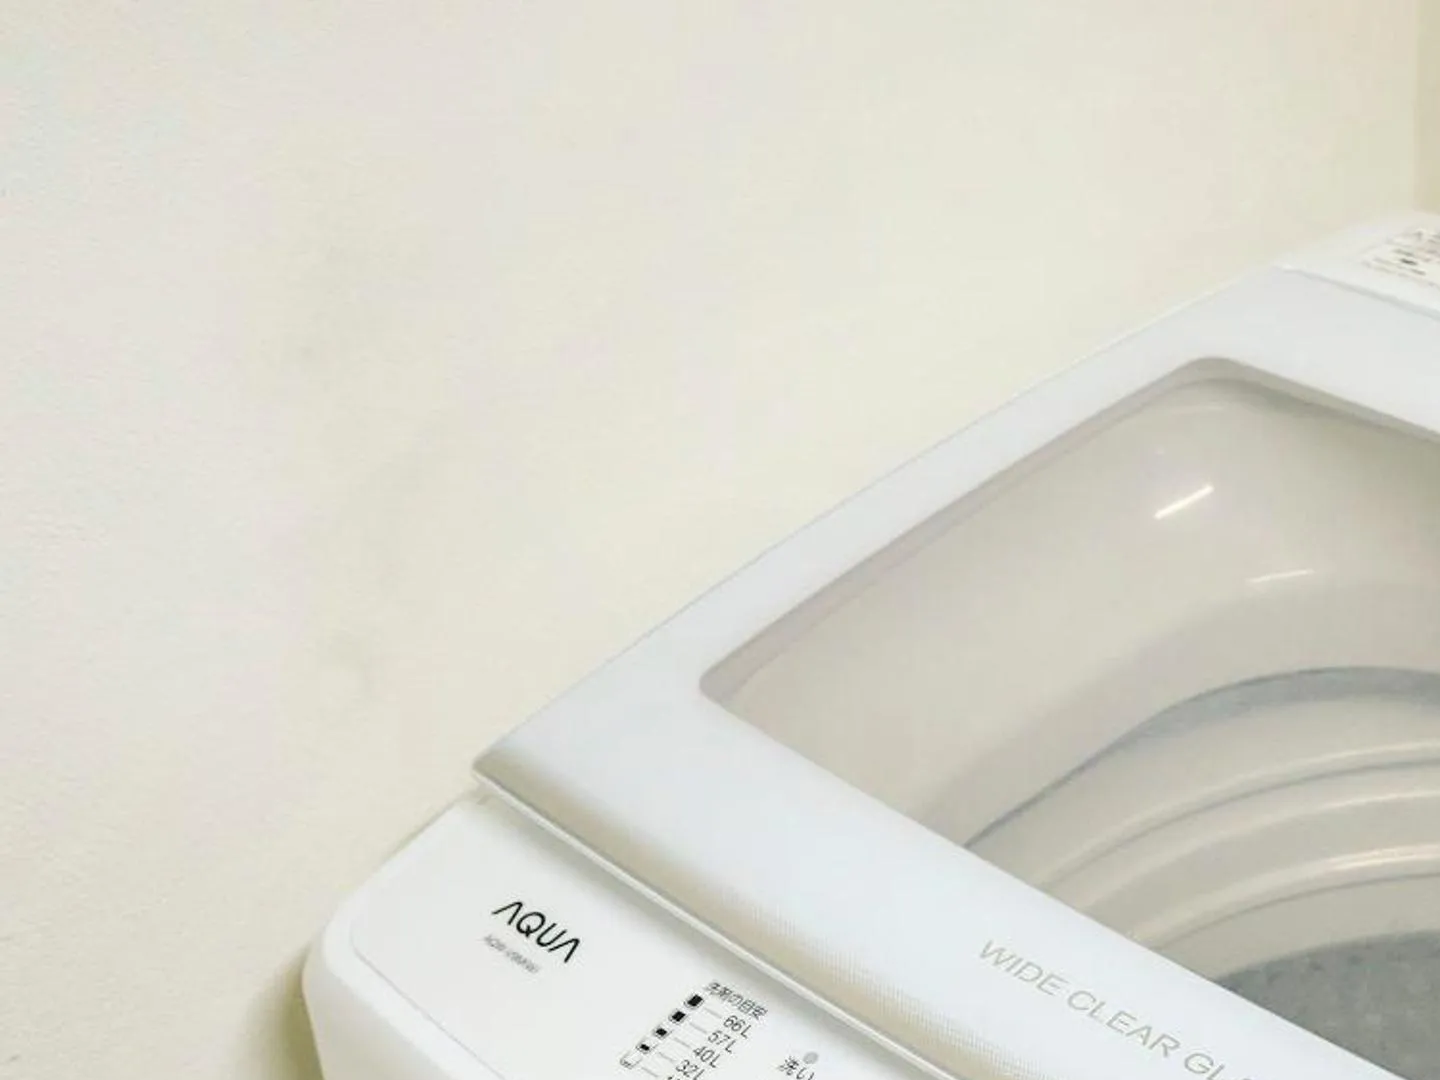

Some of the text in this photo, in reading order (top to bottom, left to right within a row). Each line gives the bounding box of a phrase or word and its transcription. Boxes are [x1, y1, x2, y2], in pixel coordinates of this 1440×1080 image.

[491, 900, 581, 964] AQUA
[978, 940, 1068, 996] WIDE
[1067, 990, 1181, 1059] CLEAR
[723, 1015, 753, 1039] 66L
[707, 1030, 737, 1054] 57L
[692, 1045, 721, 1069] 40L
